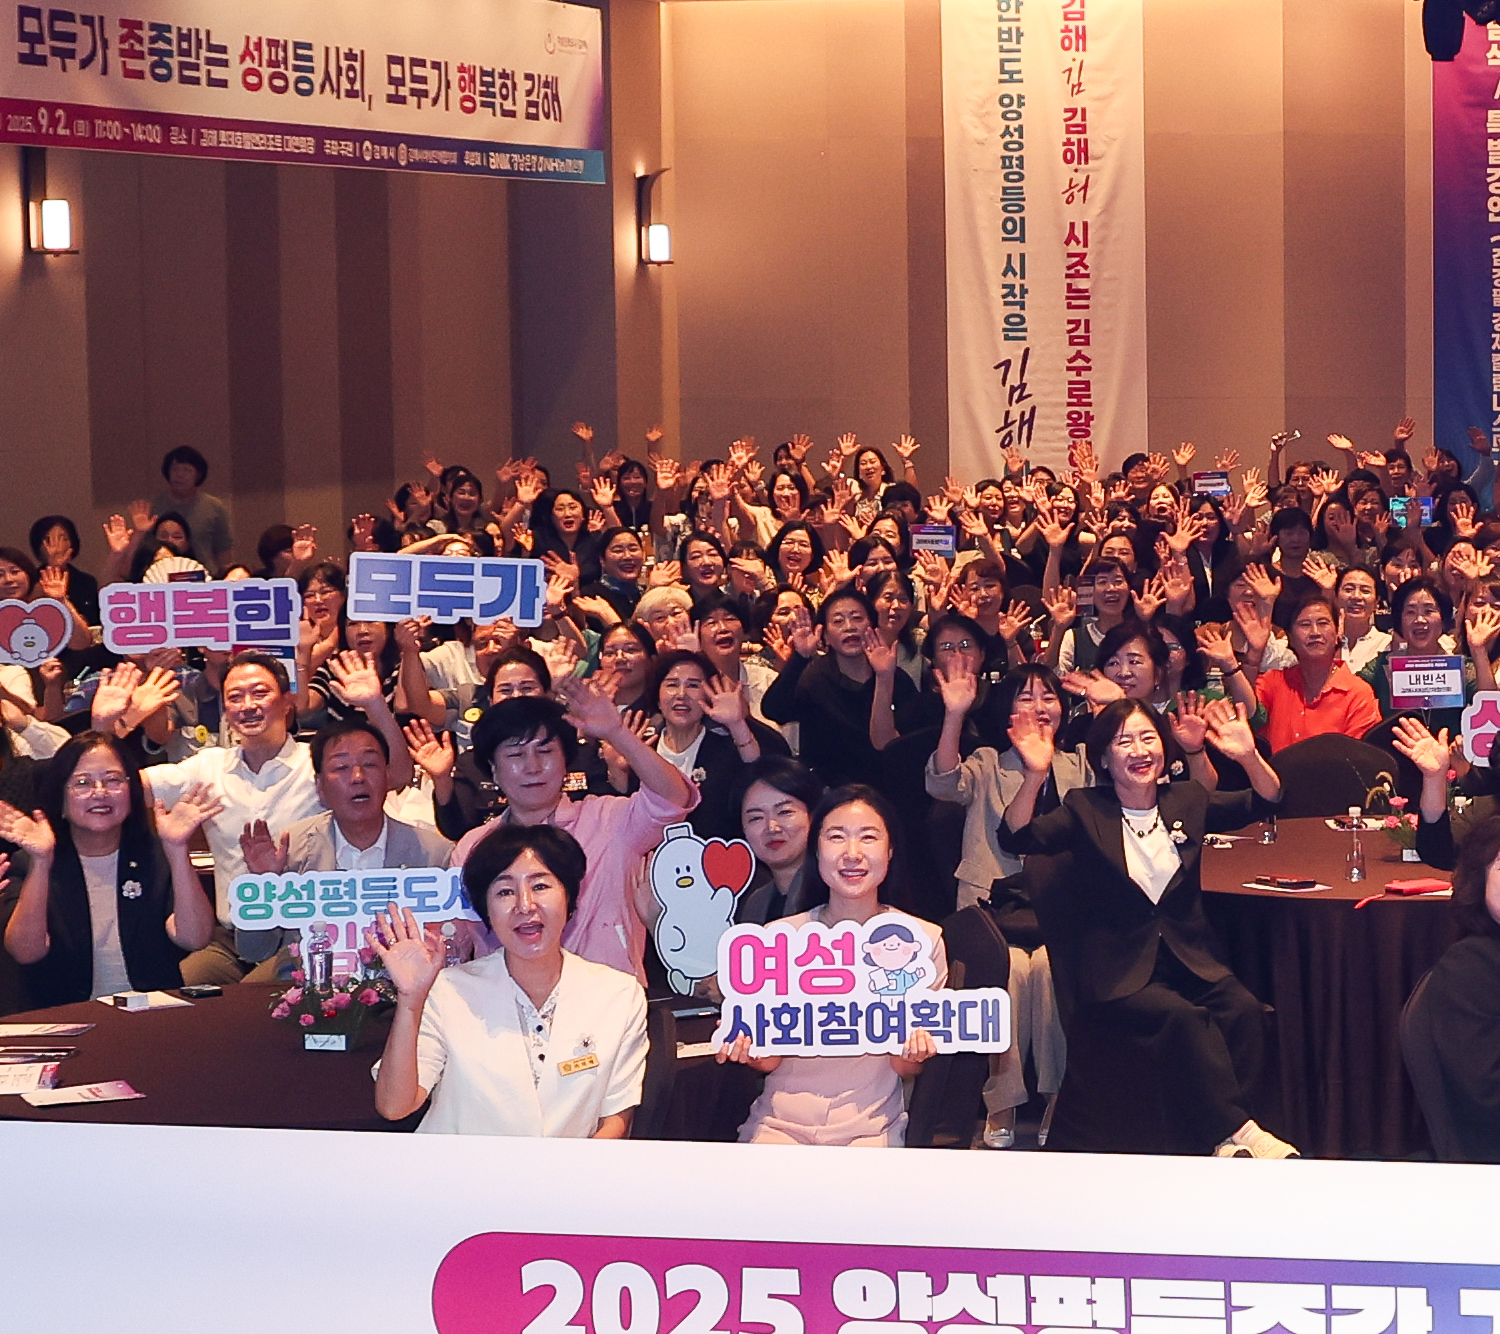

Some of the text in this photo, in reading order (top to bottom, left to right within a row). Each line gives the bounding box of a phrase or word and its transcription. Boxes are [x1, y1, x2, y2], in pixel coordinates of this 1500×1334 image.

[17, 4, 563, 124] 모두가 존중받는 성평등 사회, 모두가 행복한 김해
[998, 93, 1027, 244] 양성평등의
[1001, 252, 1029, 342] 시작은
[1063, 220, 1091, 311] 시조는
[993, 347, 1037, 449] 김해
[107, 586, 293, 646] 행복한
[354, 559, 540, 621] 모두가
[1409, 673, 1446, 686] 내빈석
[728, 932, 857, 997] 여성
[723, 998, 1002, 1047] 사회참여확대
